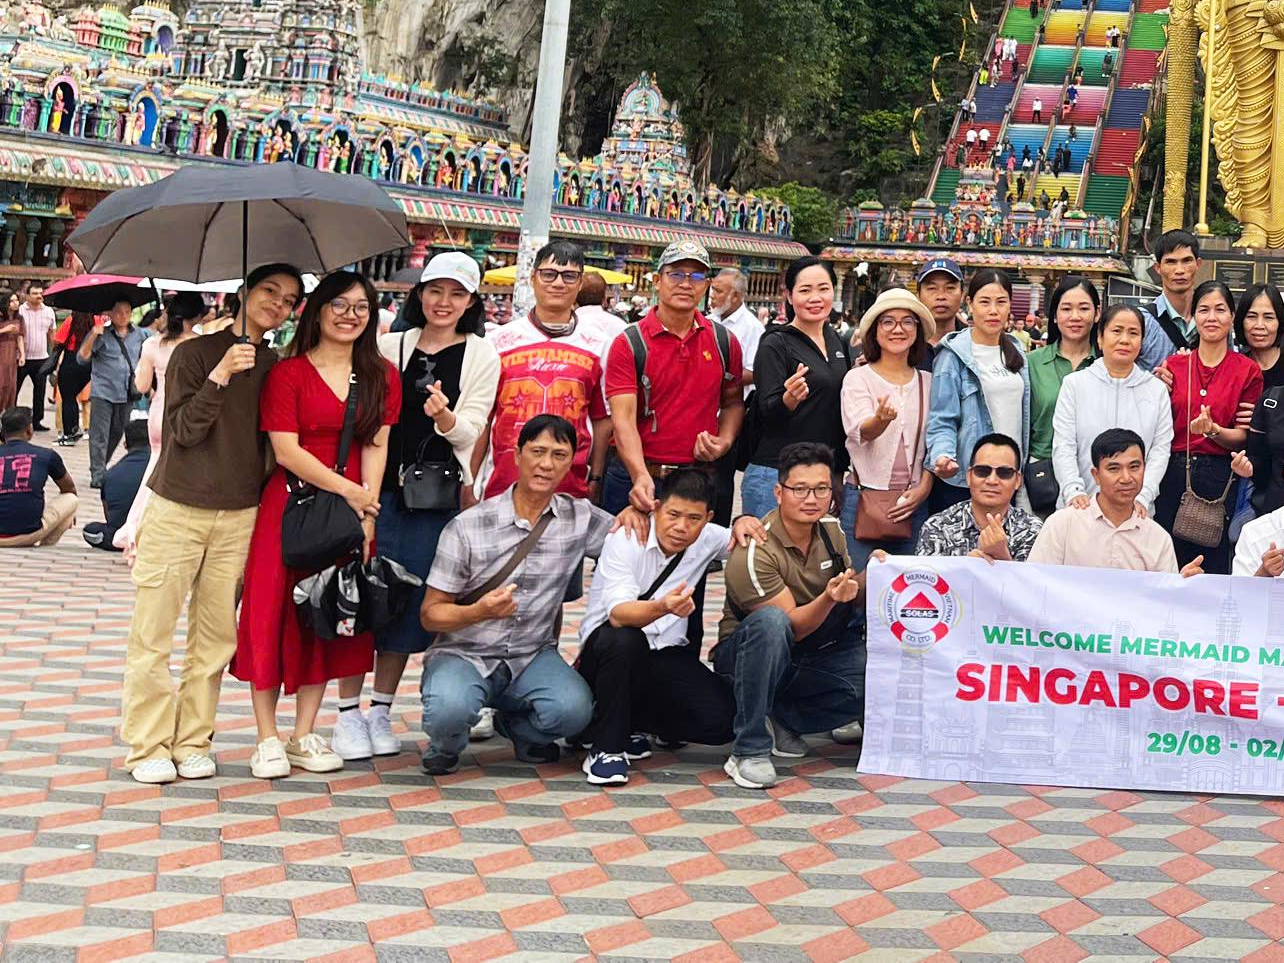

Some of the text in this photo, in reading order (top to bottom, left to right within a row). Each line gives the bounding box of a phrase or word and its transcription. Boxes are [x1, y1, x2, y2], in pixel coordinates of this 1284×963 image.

[906, 574, 936, 583] MERMAID
[886, 591, 895, 623] MARITIME
[905, 610, 934, 618] SOLAS
[945, 593, 953, 623] VIETNAM
[982, 625, 1112, 654] WELCOME
[1119, 636, 1251, 664] MERMAID
[955, 663, 1259, 720] SINGAPORE
[1147, 731, 1222, 756] 29/08
